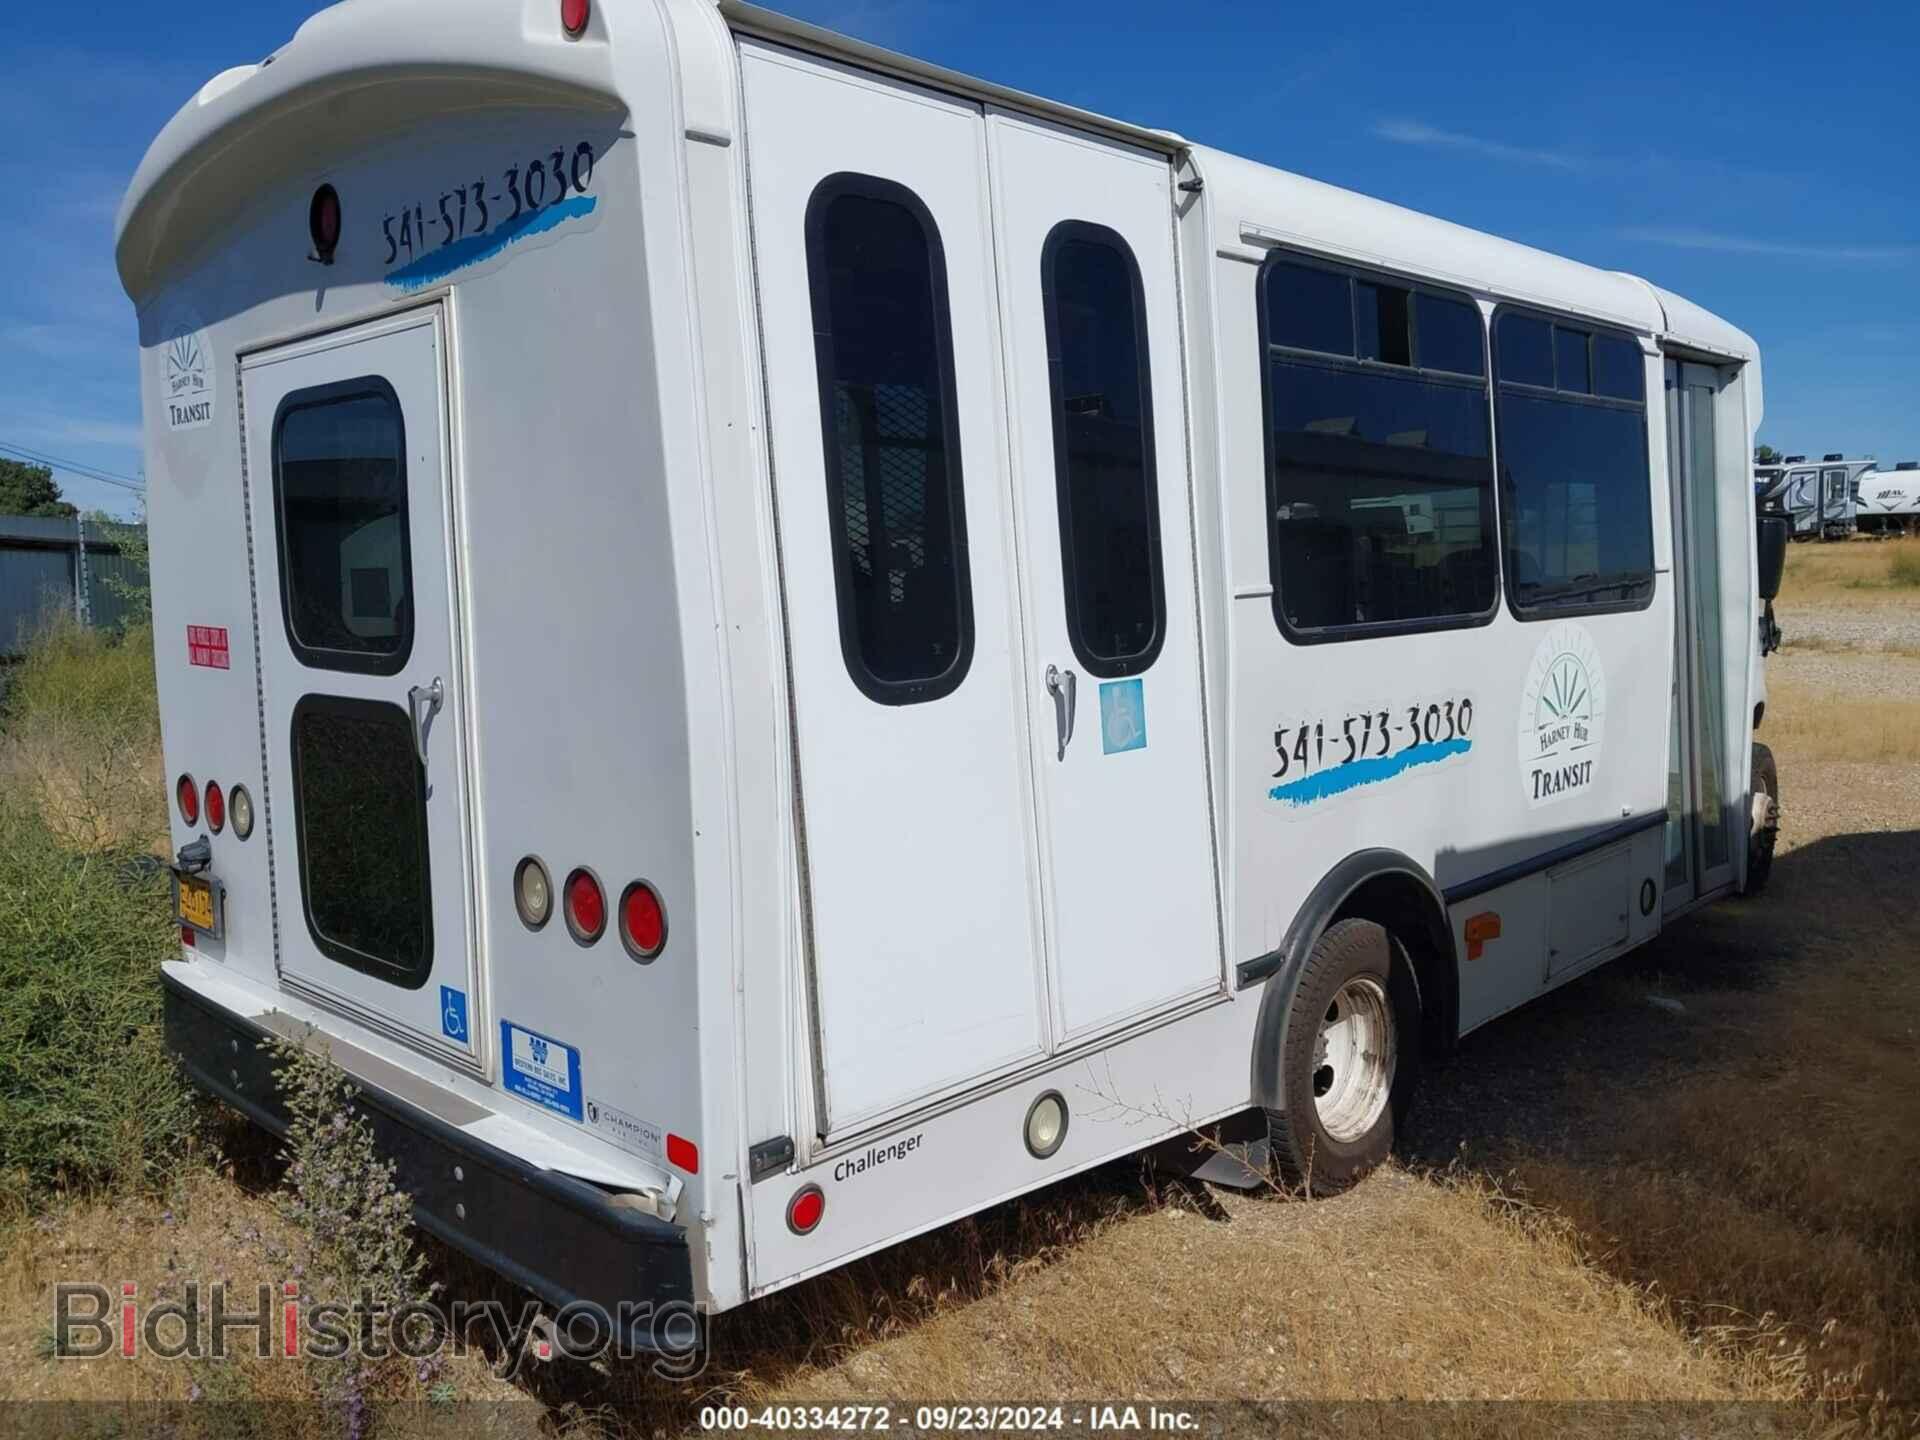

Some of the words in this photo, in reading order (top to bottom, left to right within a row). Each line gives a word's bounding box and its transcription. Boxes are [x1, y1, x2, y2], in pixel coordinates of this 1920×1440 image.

[382, 141, 594, 265] 541-573-3030
[169, 401, 210, 426] TRANSIT
[1271, 696, 1473, 778] 541-573-3030
[1540, 725, 1571, 752] HARNEY
[1573, 721, 1589, 742] HUB
[1531, 760, 1592, 800] TRANSIT
[834, 1133, 923, 1182] Challenger
